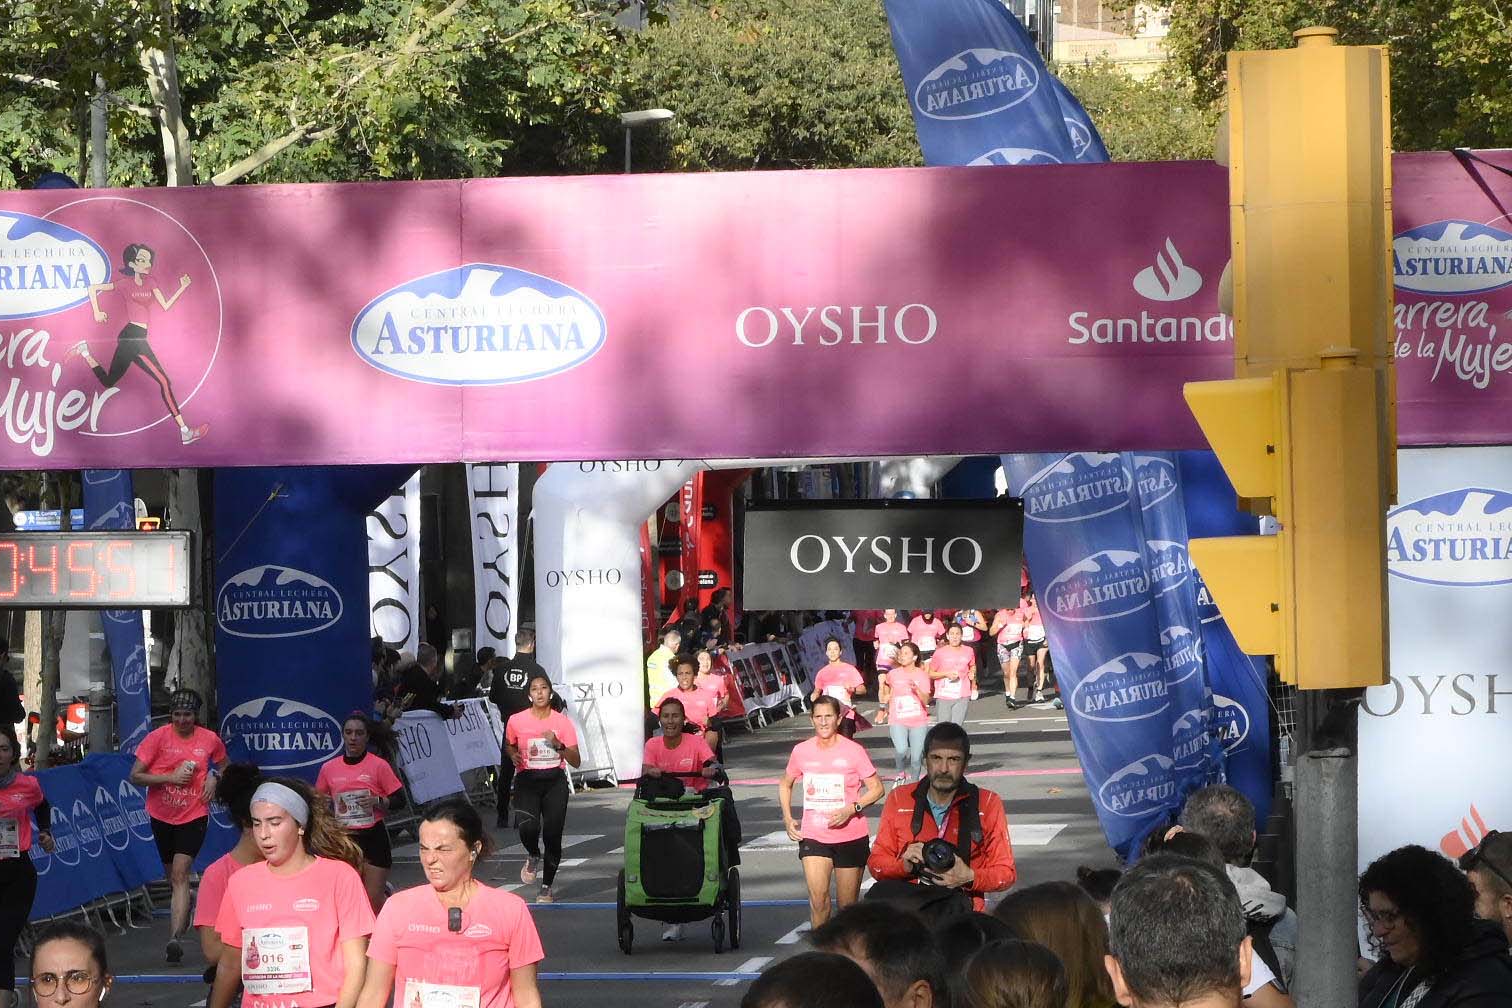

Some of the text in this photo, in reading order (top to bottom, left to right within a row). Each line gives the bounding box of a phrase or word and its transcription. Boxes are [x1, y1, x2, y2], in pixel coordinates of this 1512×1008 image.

[1465, 244, 1512, 253] LECHER
[735, 303, 938, 348] OYSHO
[1068, 311, 1234, 344] Santand
[1394, 301, 1489, 330] arrera
[371, 311, 586, 356] ASTURIANA
[1417, 325, 1512, 389] la Muje
[790, 534, 983, 575] OYSHO
[546, 567, 622, 588] OYSHO
[233, 589, 276, 598] CENTRAL
[221, 595, 334, 622] ASTURIANA
[510, 673, 522, 683] BP
[1362, 673, 1512, 718] OYSH
[261, 953, 284, 964] 016
